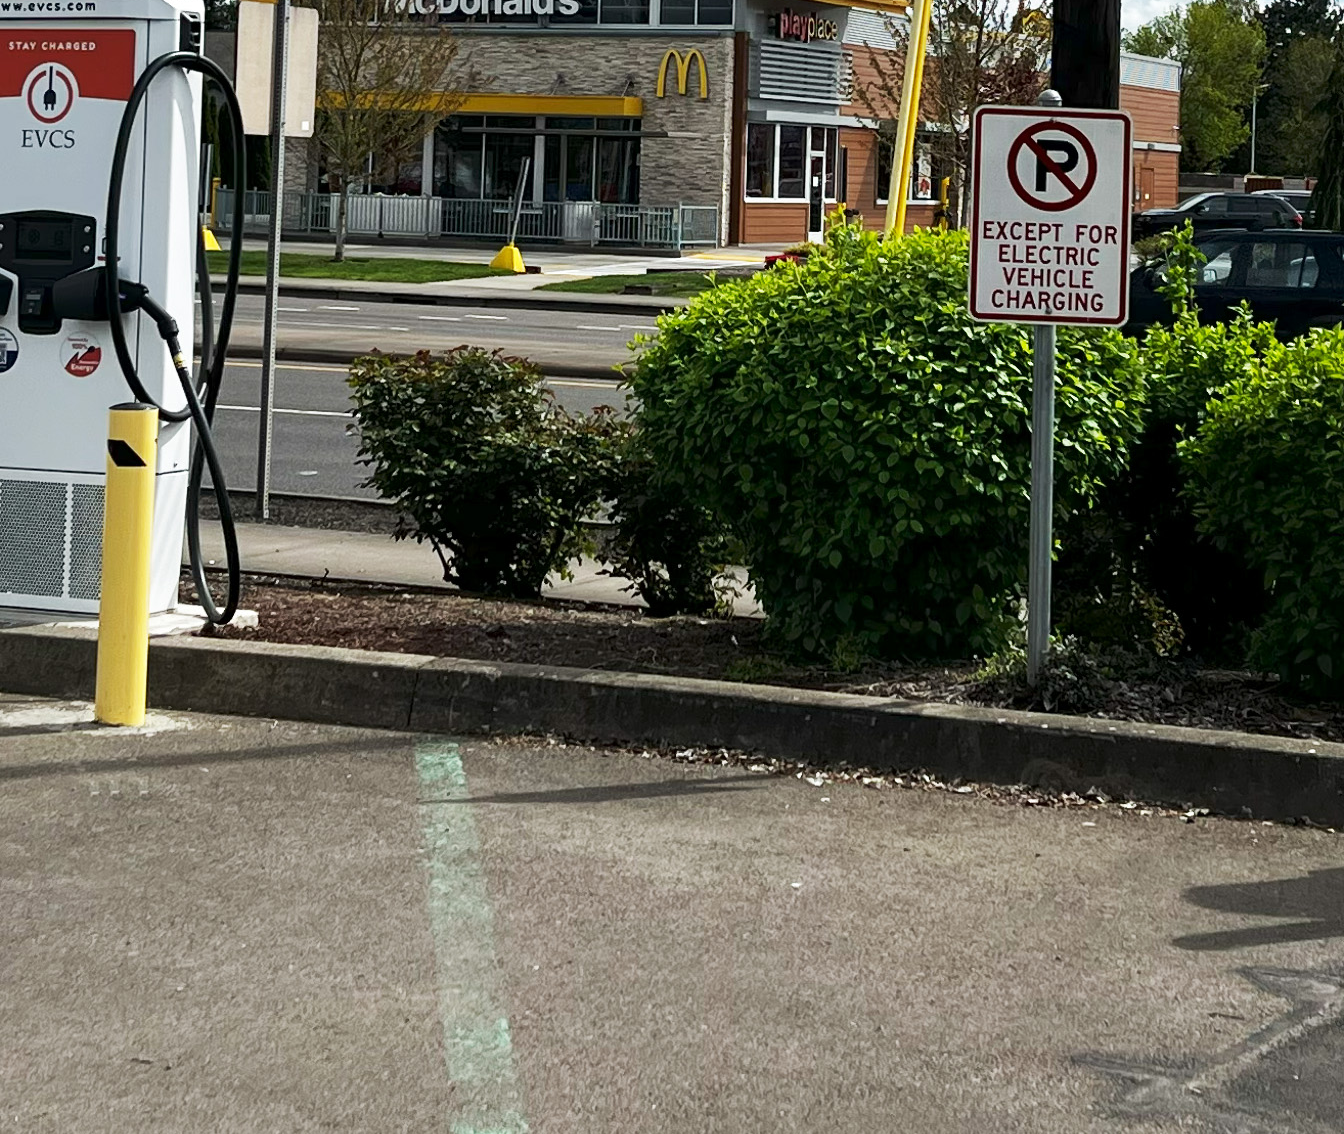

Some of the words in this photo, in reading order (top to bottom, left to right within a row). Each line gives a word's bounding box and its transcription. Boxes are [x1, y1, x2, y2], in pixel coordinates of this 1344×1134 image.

[780, 8, 838, 44] playplace
[8, 41, 37, 51] STAY
[41, 41, 96, 51] CHARGED
[21, 129, 76, 148] EVCS
[983, 221, 1063, 242] EXCEPT
[1076, 225, 1117, 244] FOR
[999, 244, 1100, 266] ELECTRIC
[1002, 267, 1094, 289] VEHICLE
[991, 289, 1104, 312] CHARGING
